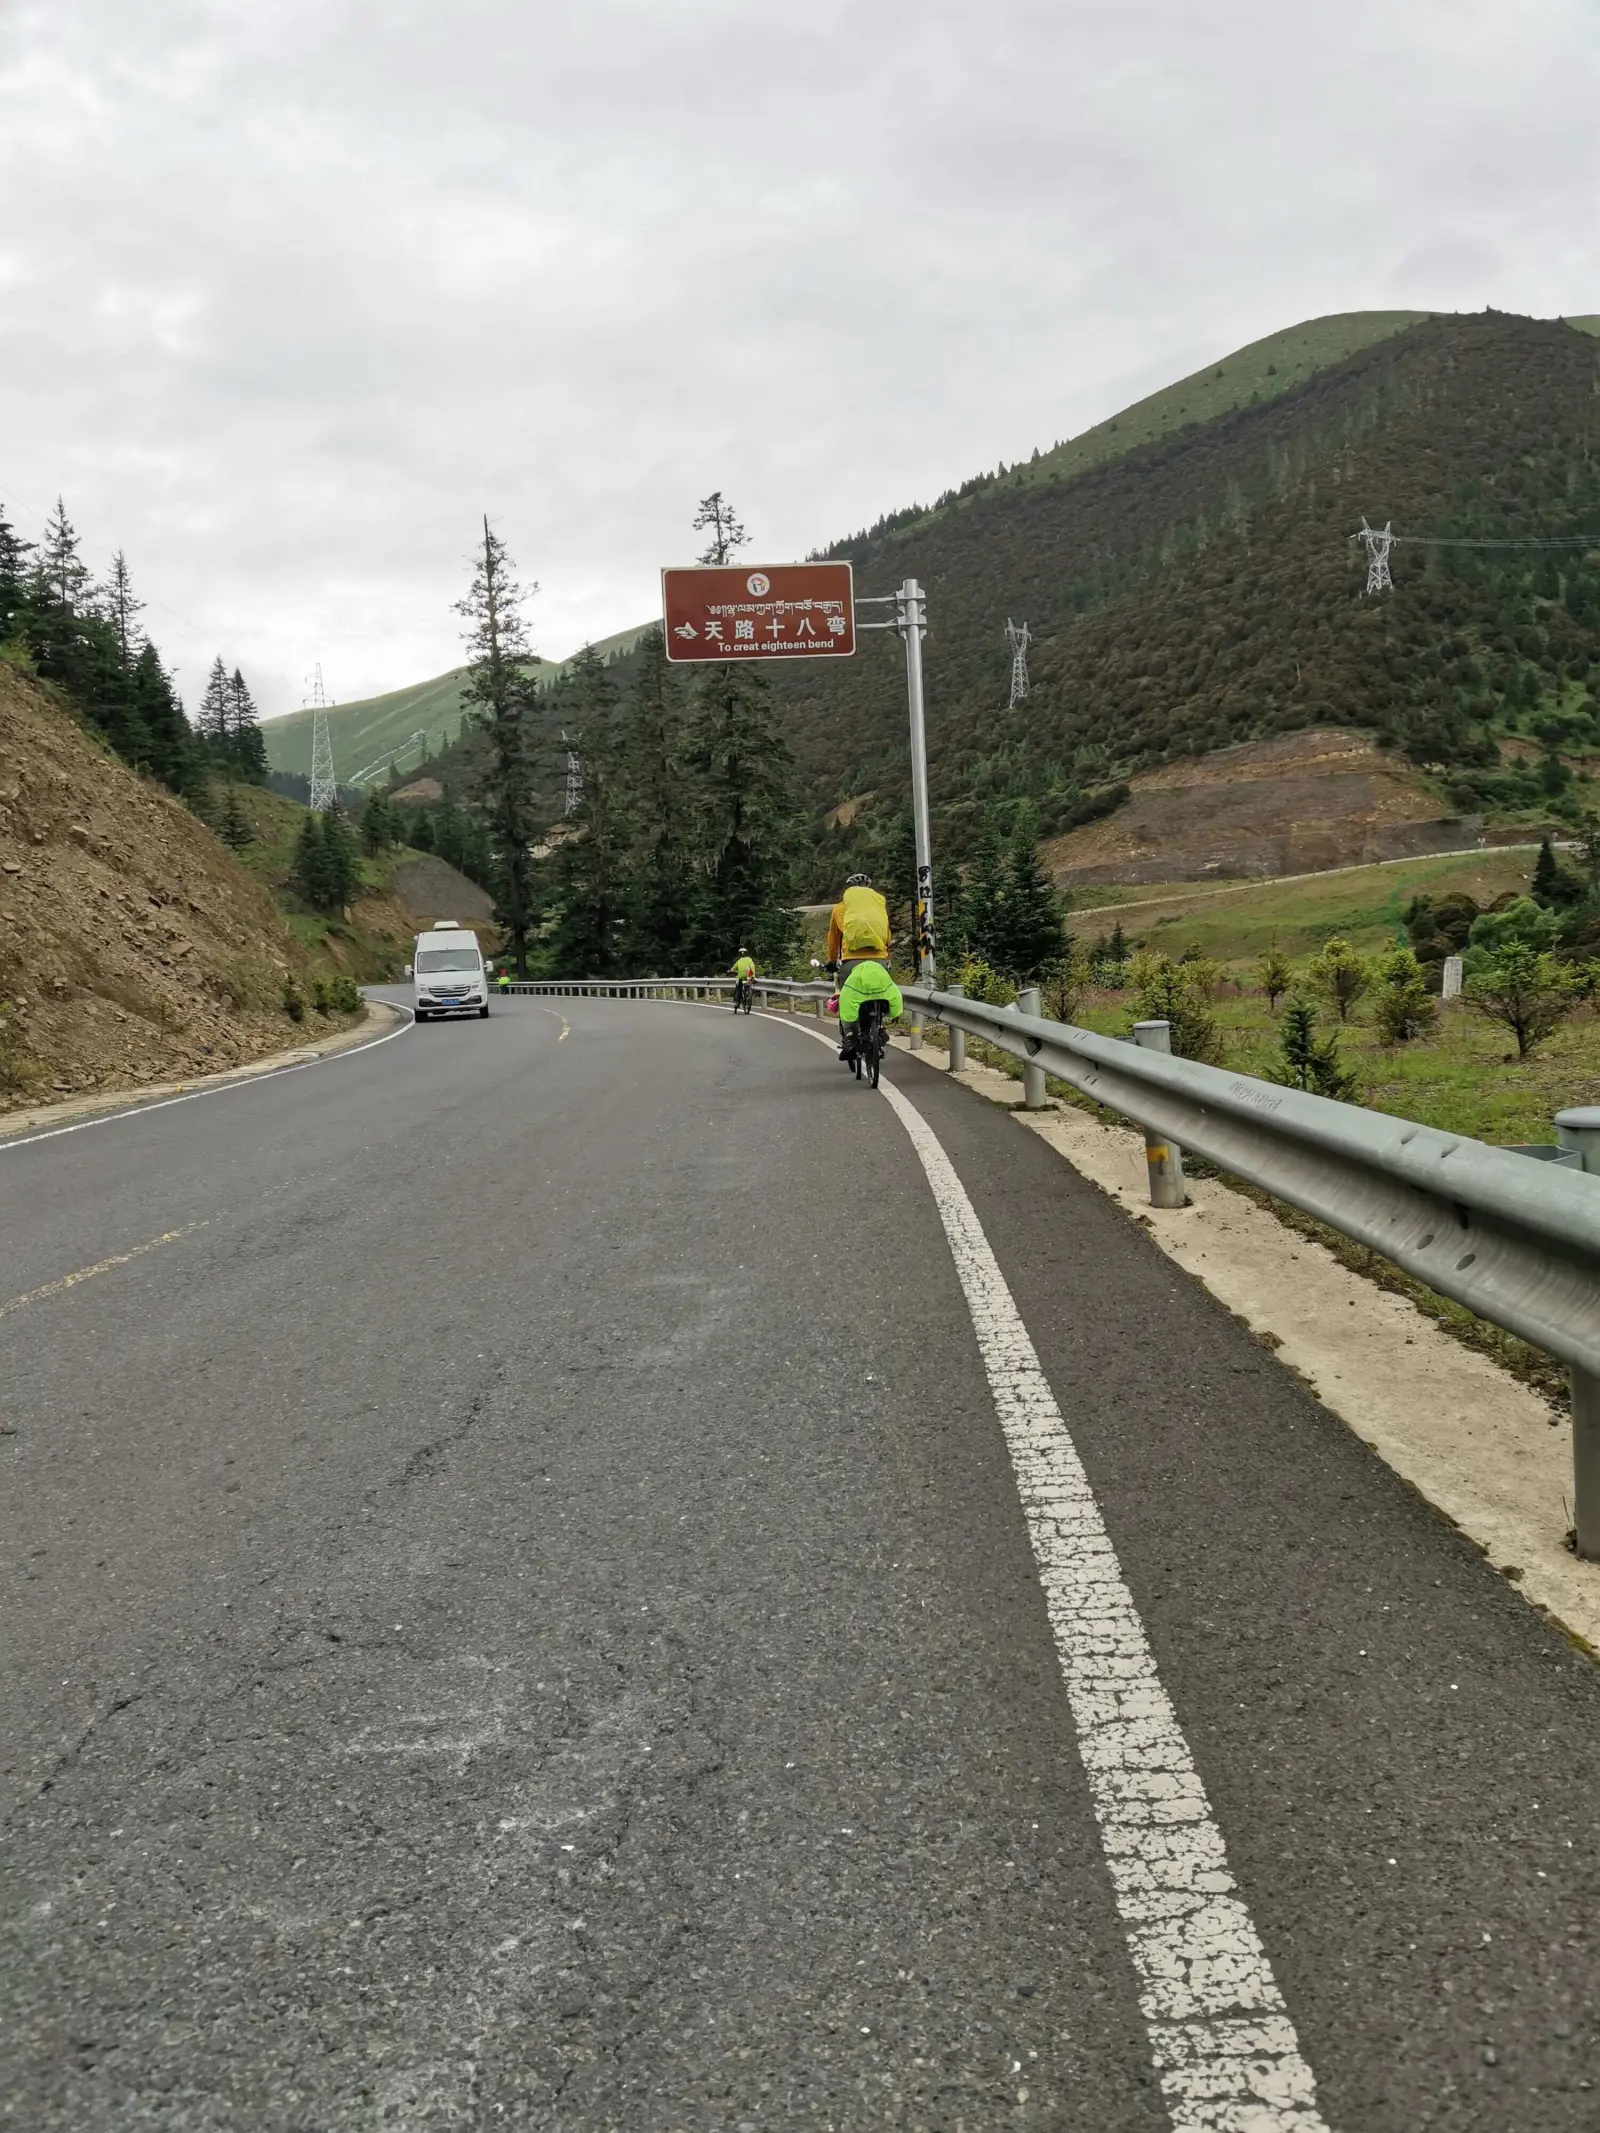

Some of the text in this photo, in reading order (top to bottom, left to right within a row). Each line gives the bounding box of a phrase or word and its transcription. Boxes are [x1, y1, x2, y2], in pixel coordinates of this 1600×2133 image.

[704, 616, 846, 640] 天路十八弯
[718, 638, 834, 651] To creat eighteen bend
